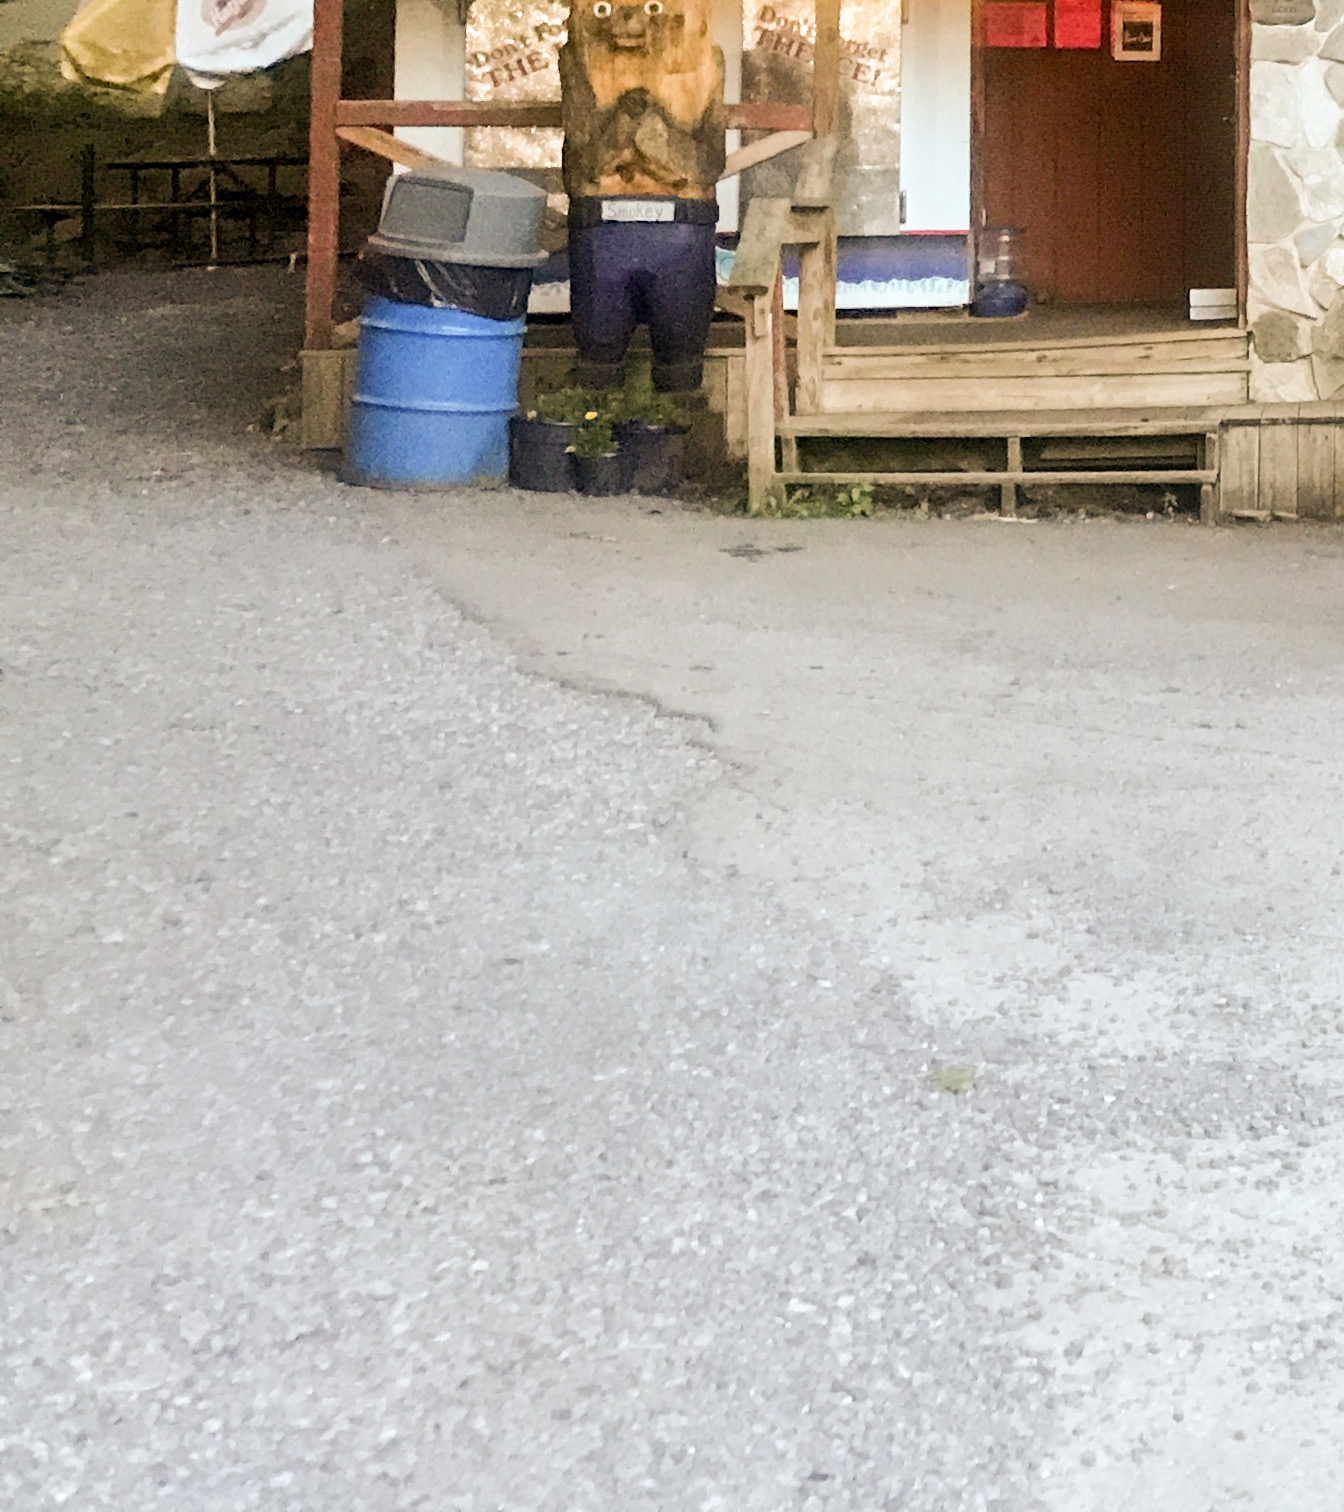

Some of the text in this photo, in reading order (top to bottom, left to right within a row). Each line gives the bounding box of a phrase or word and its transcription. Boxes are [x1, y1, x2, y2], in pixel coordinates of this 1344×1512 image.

[755, 25, 814, 62] THE
[481, 50, 549, 88] THE
[837, 56, 881, 87] CE!
[607, 202, 665, 219] Smokey
